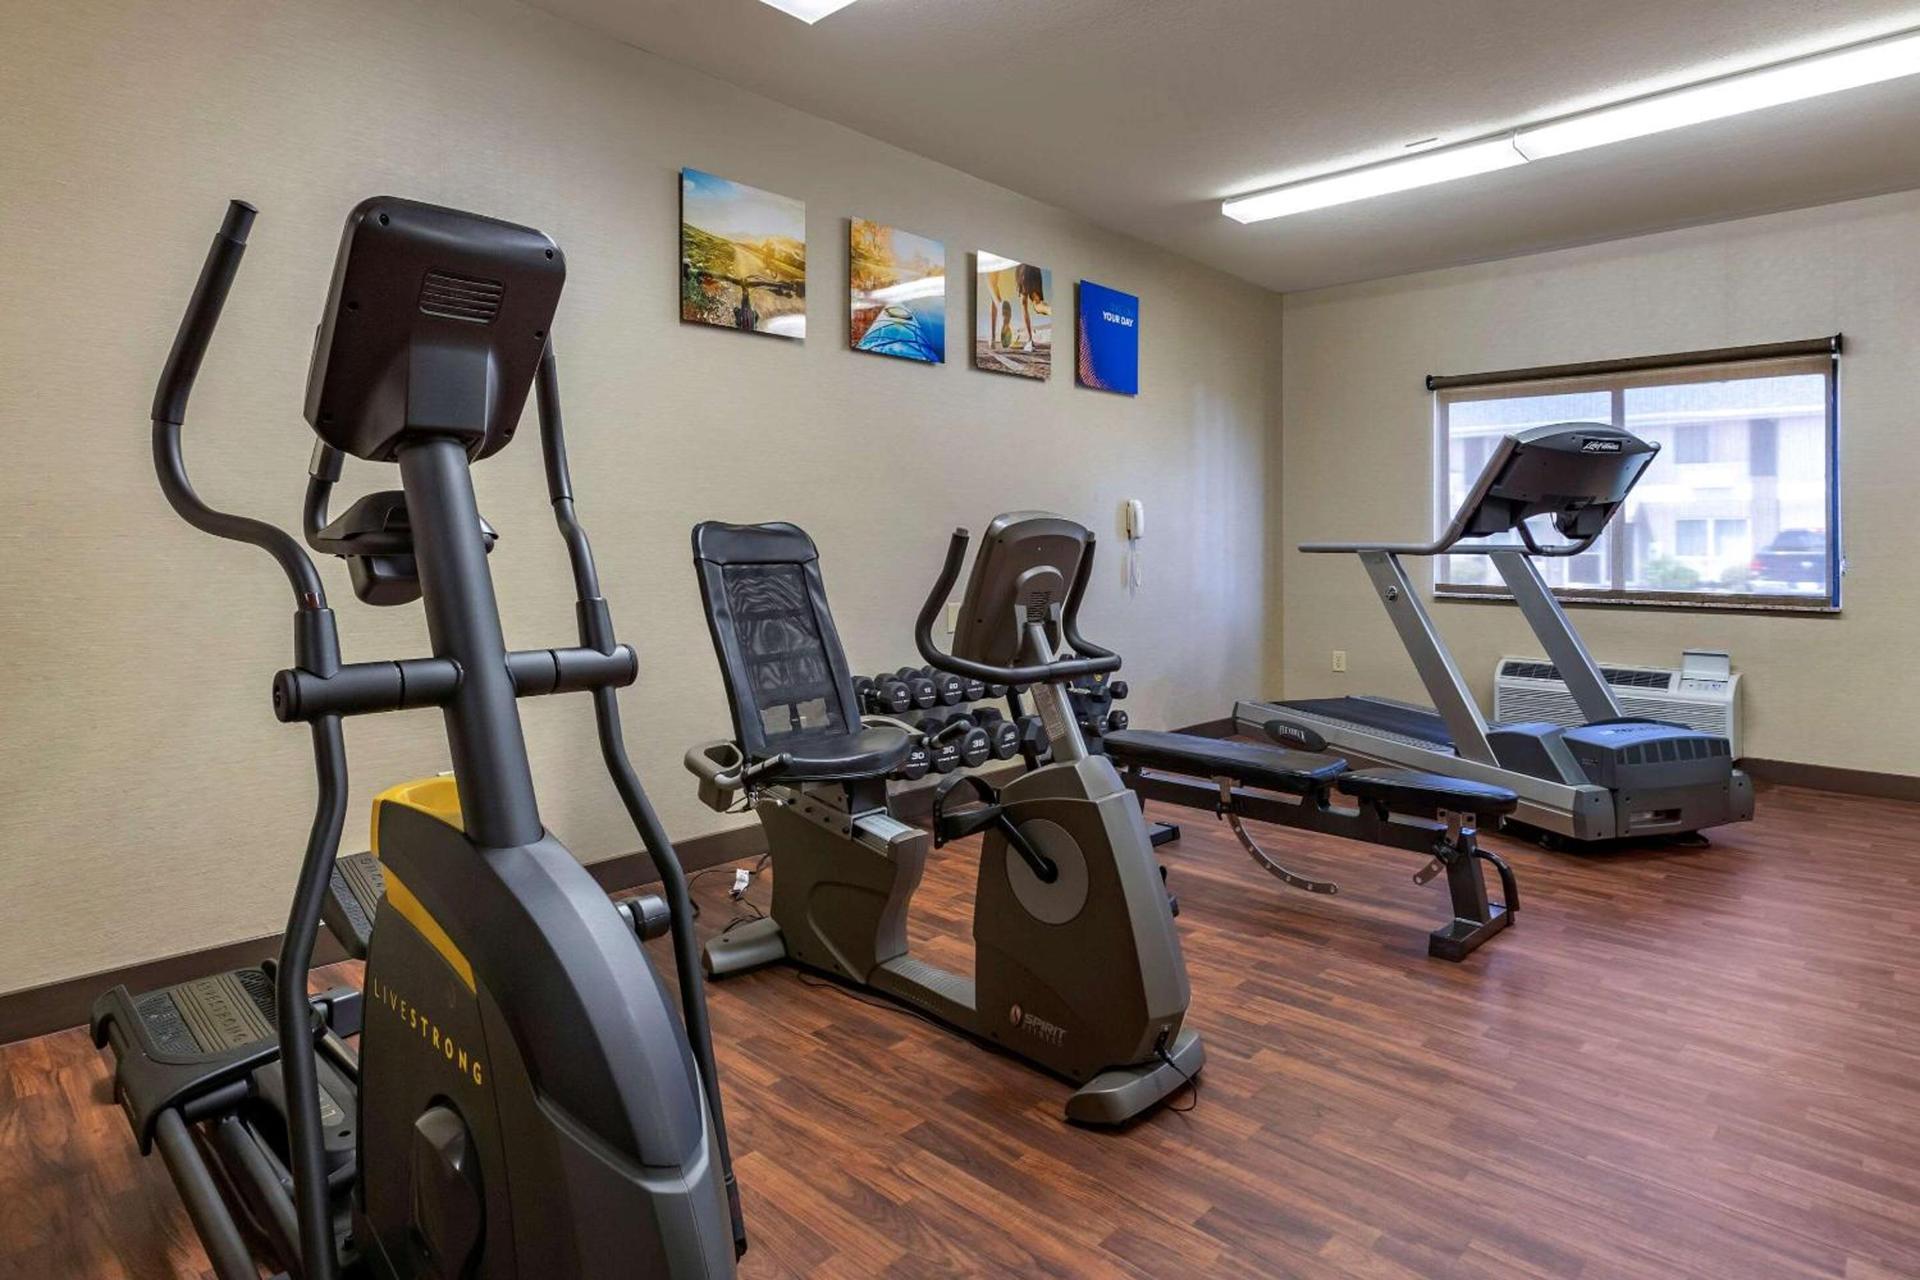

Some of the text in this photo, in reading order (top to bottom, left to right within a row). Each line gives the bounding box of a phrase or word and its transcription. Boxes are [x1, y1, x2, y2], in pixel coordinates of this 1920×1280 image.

[1103, 310, 1134, 327] YOUR DAY
[971, 738, 985, 748] 35
[911, 751, 925, 760] 30
[942, 745, 955, 755] 30
[374, 977, 482, 1085] LIVESTRONG
[1024, 1013, 1067, 1038] SPIRIT
